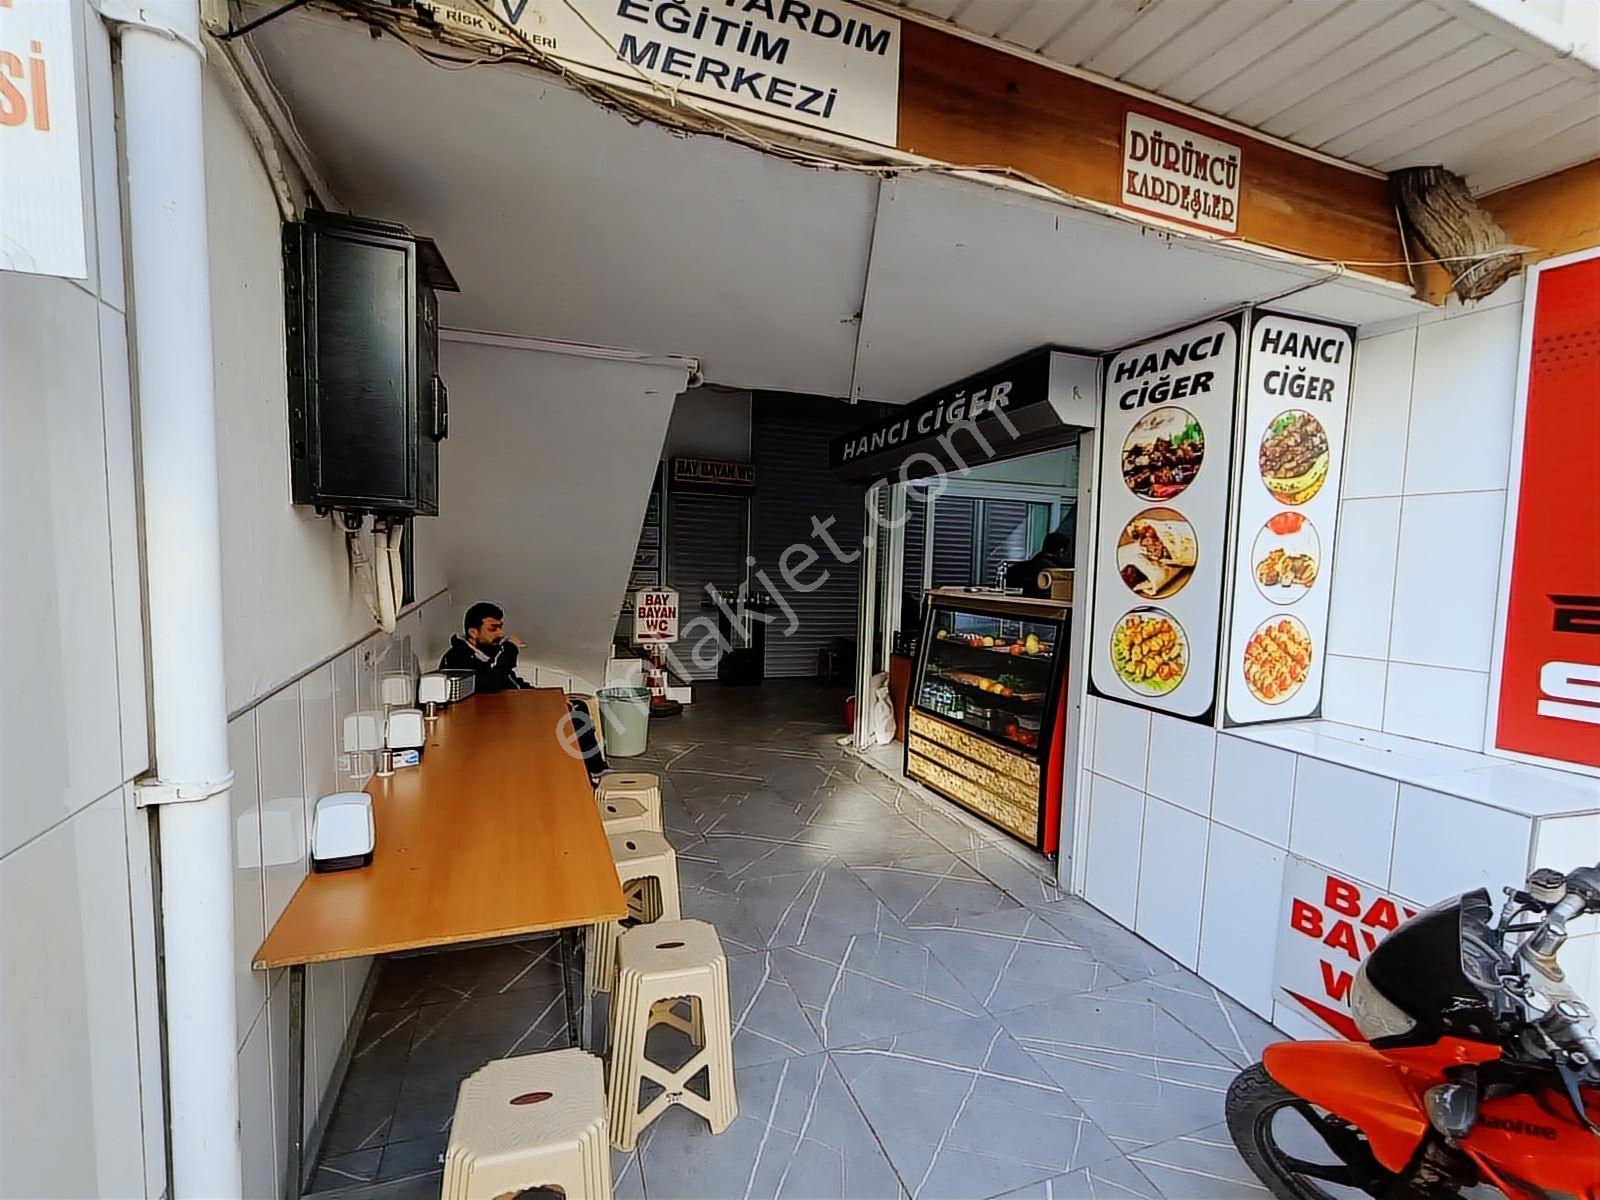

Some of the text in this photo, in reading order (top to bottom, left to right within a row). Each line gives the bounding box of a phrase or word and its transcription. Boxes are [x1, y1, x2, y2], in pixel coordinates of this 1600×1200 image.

[617, 0, 790, 64] EĞİTİM
[617, 33, 838, 119] MERKEZİ
[1130, 130, 1238, 190] DÜRÜMCÜ
[1126, 169, 1234, 223] KARDEŞLER
[1114, 332, 1225, 384] HANCI
[1260, 328, 1345, 364] HANCI
[1119, 371, 1214, 411] CİĞER
[1264, 365, 1335, 403] CİĞER
[843, 380, 1013, 461] HANCI CİĞER
[638, 607, 677, 619] BAYAN
[645, 594, 670, 606] BAY
[646, 620, 669, 632] WC
[1325, 875, 1418, 931] BA
